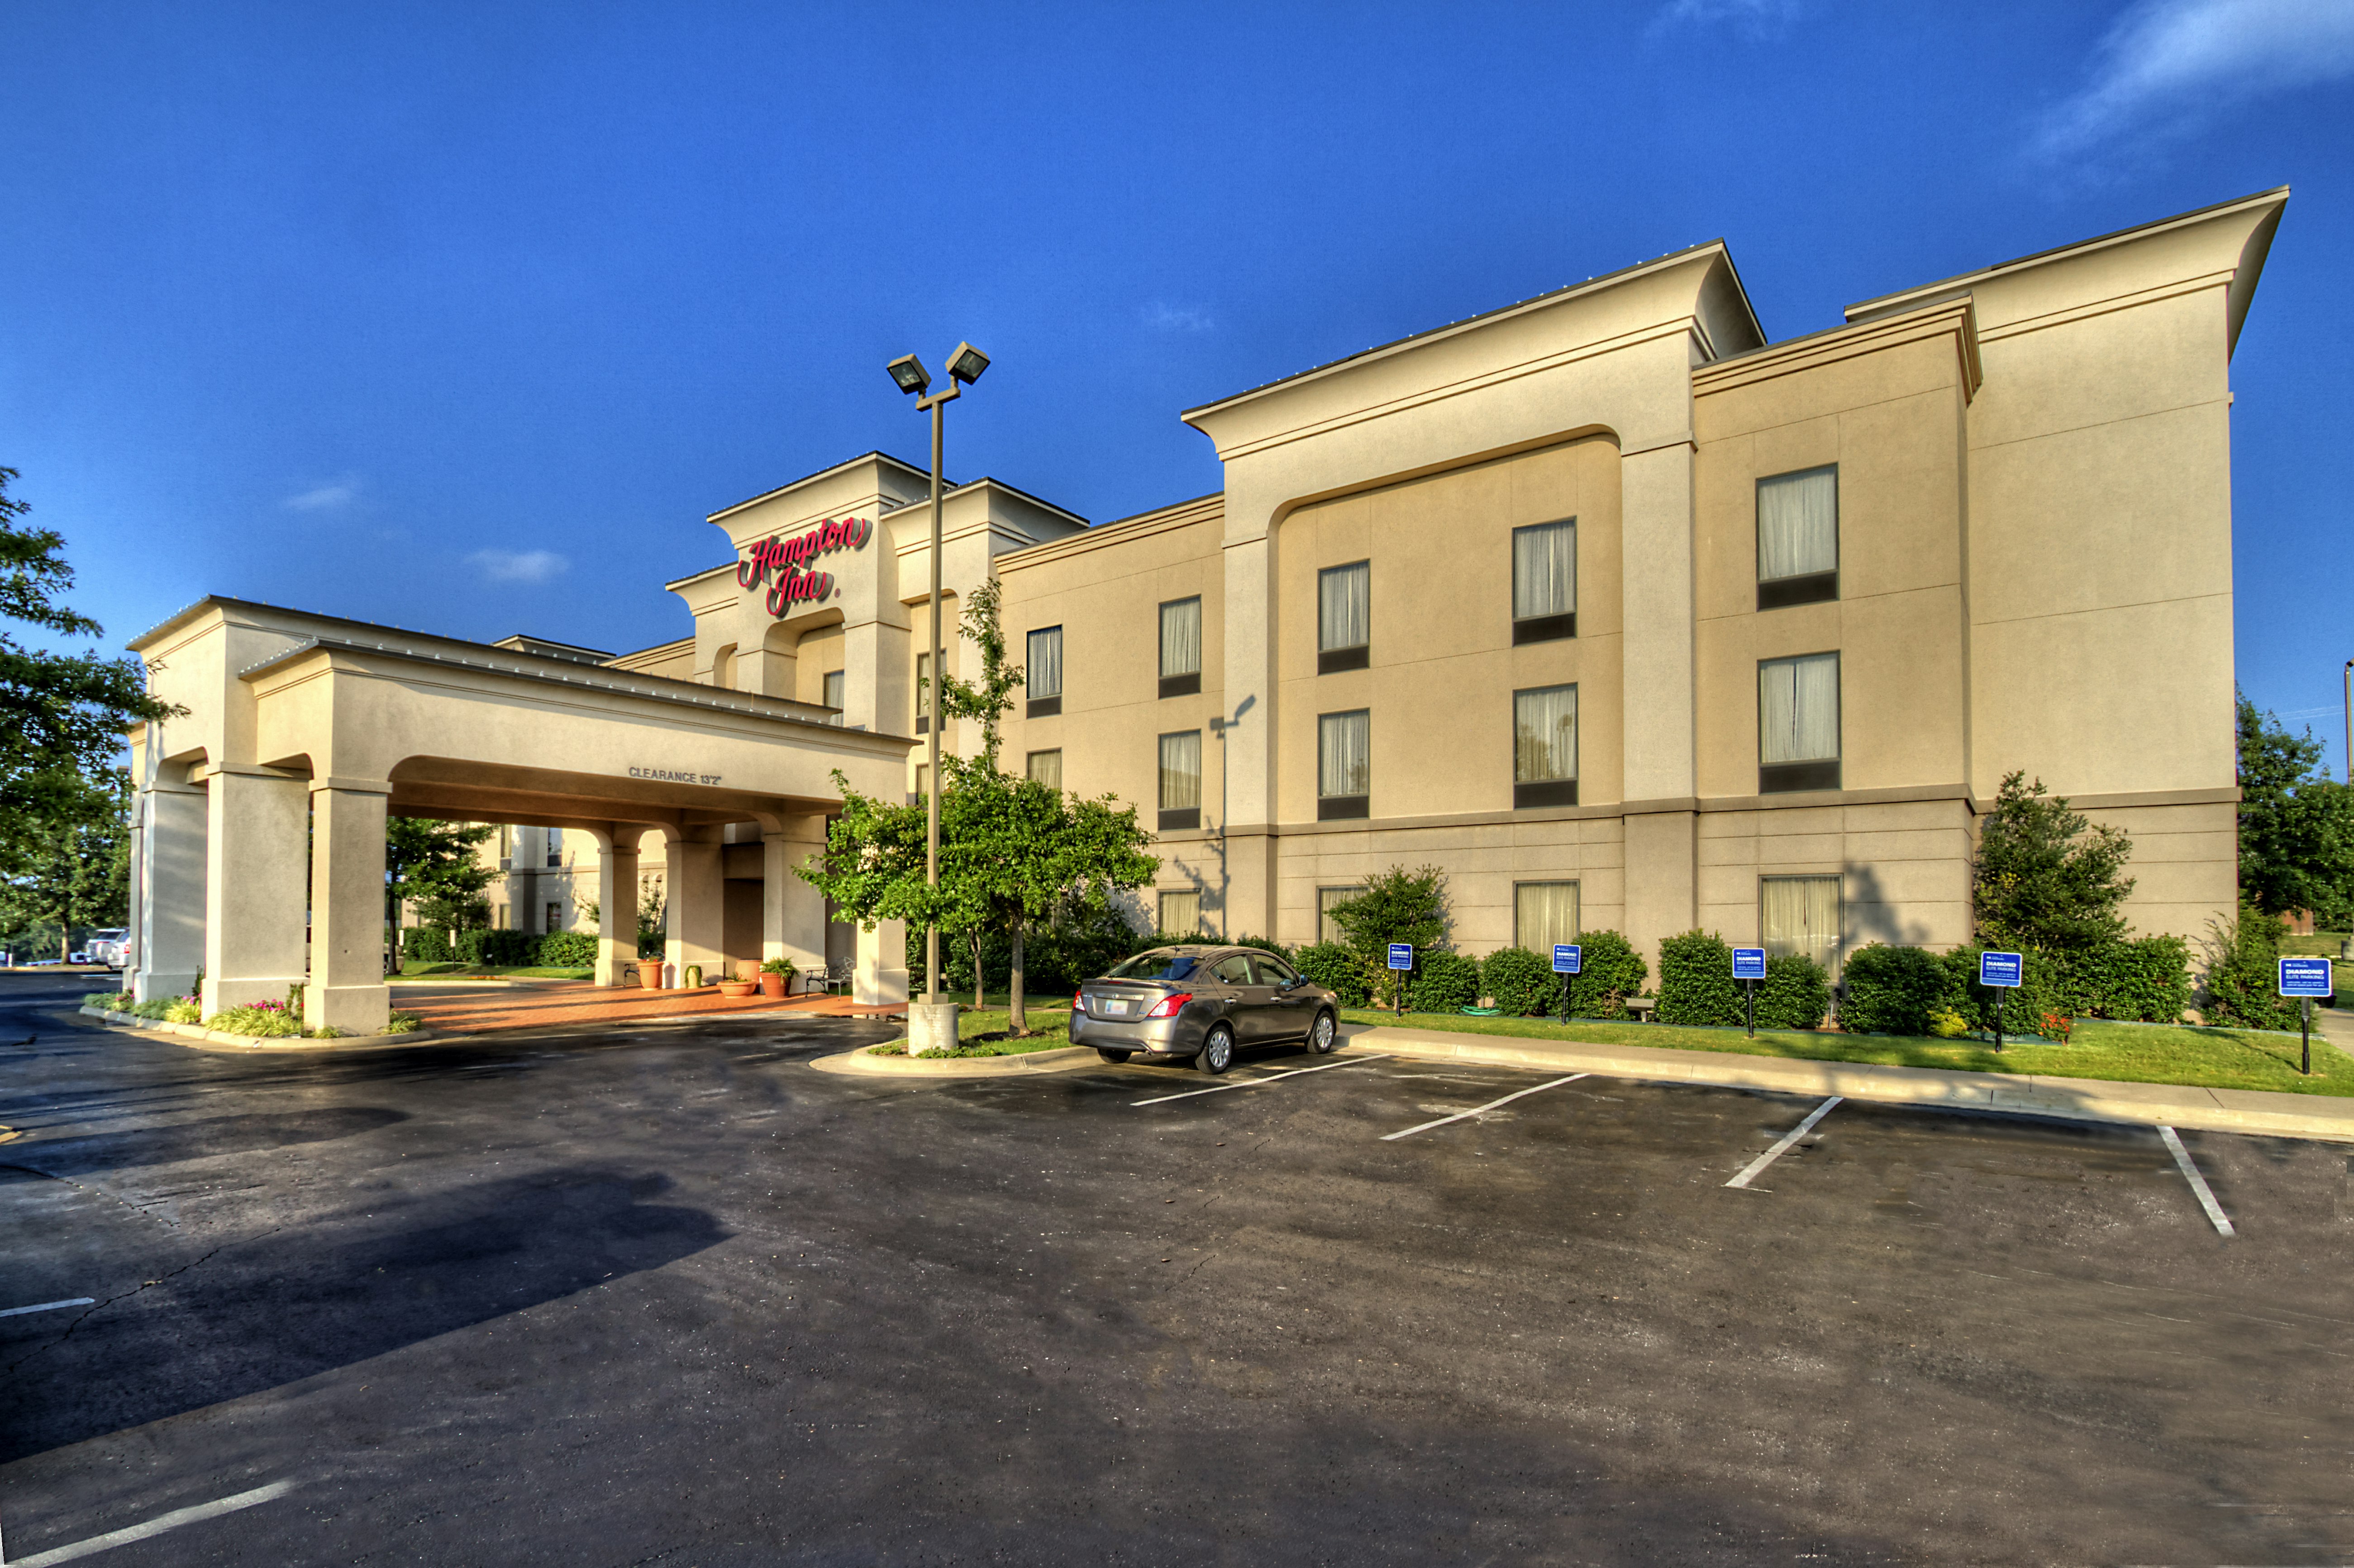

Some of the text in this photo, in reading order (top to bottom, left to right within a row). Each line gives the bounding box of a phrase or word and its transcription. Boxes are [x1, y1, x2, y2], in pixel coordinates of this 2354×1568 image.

[738, 517, 867, 588] Hampton
[767, 566, 829, 616] Inn
[629, 767, 722, 785] CLEARANCE 13'2"
